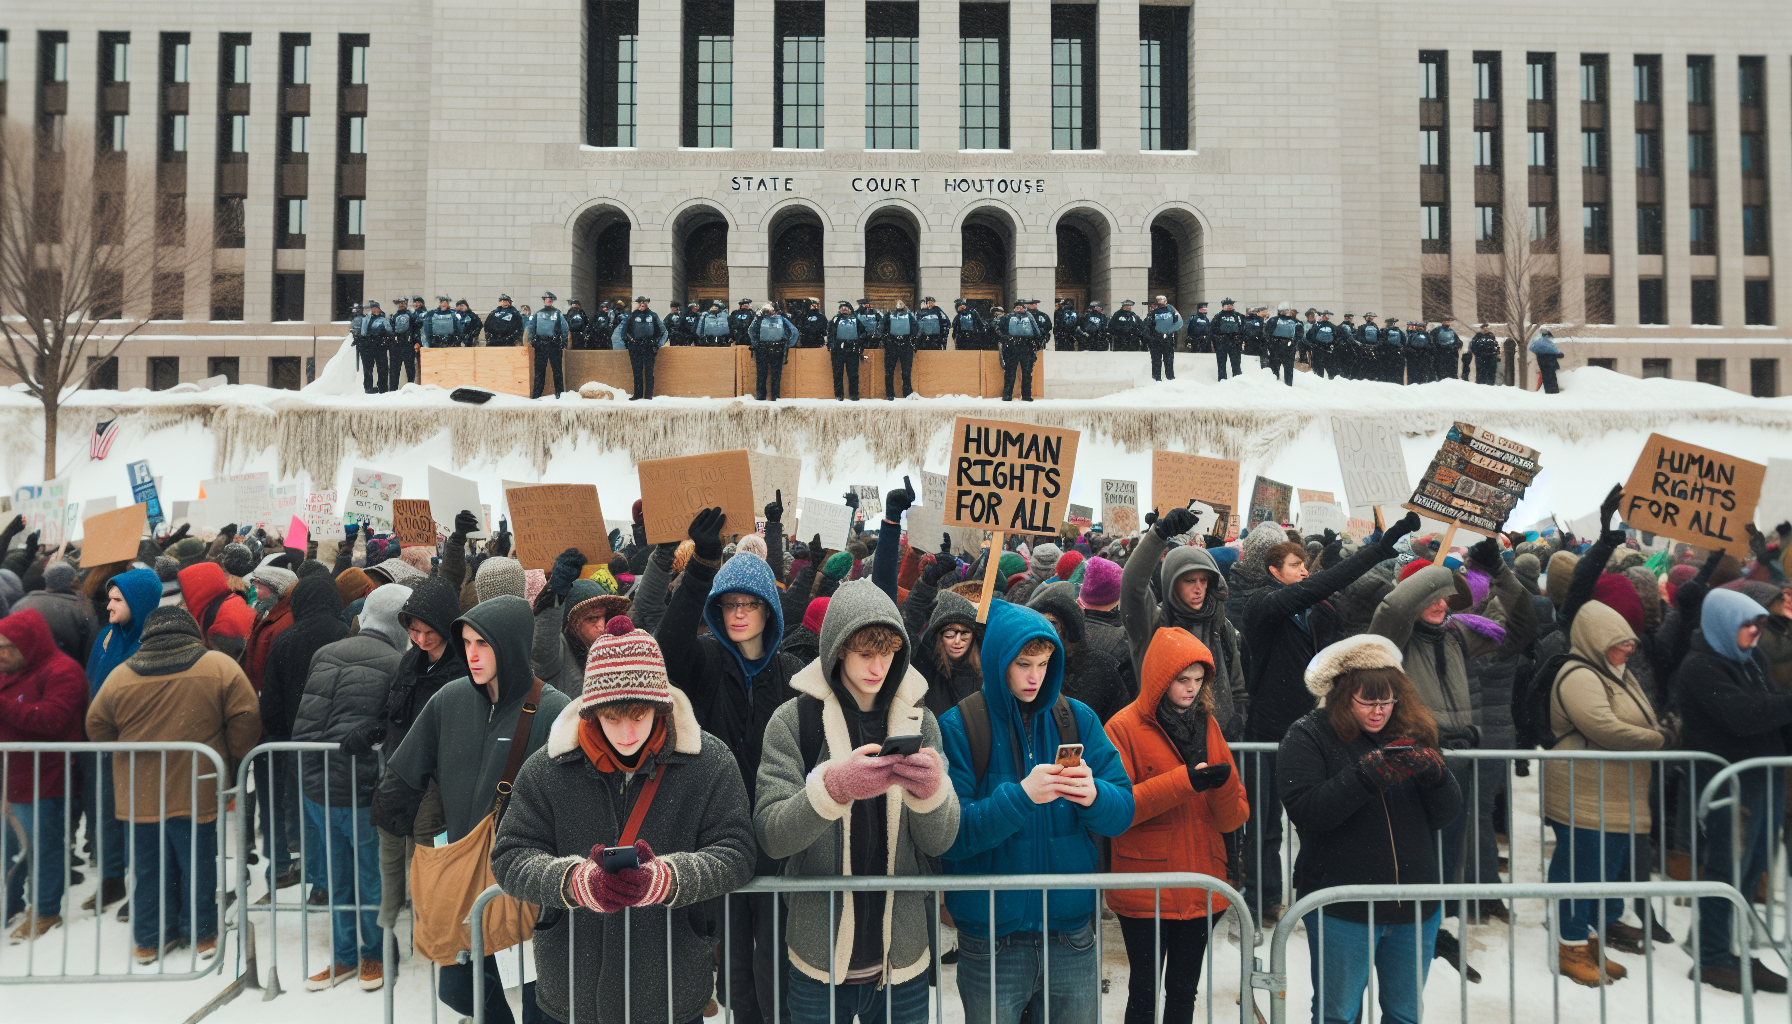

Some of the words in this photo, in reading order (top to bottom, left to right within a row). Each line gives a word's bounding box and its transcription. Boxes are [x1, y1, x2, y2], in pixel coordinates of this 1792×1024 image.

[731, 176, 794, 192] STATE
[851, 177, 921, 193] COURT
[963, 423, 1062, 466] HUMAN
[1656, 446, 1736, 486] HUMAN
[956, 456, 1061, 499] RIGHTS
[1651, 471, 1736, 512] RIGHTS
[955, 489, 1003, 526] FOR
[1009, 497, 1056, 533] ALL
[1627, 495, 1680, 527] FOR
[1687, 510, 1734, 542] ALL
